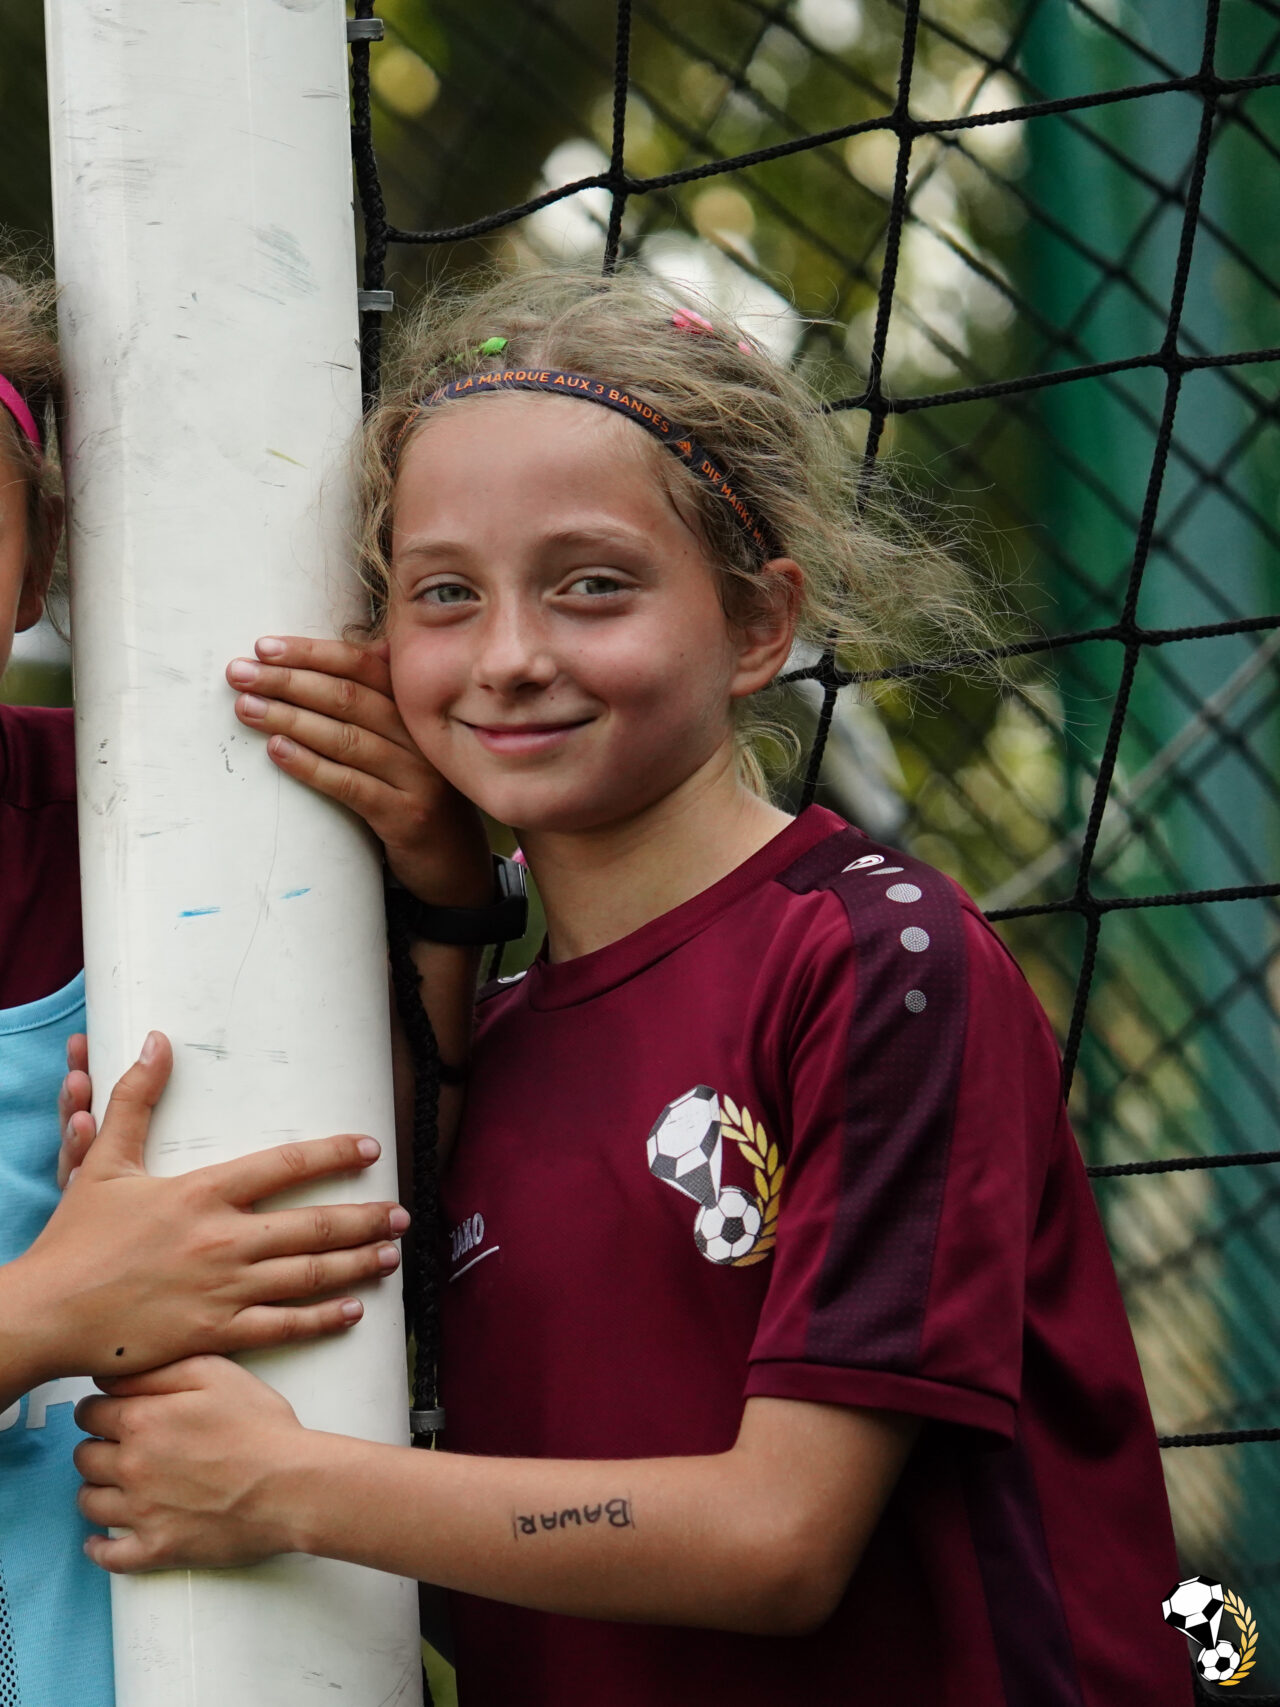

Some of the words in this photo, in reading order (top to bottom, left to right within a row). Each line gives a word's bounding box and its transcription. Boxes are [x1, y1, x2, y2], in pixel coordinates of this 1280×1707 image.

[455, 378, 474, 392] LA
[554, 375, 591, 391] AUX
[594, 384, 605, 394] 3
[608, 389, 670, 433] BANDES
[701, 460, 722, 486] DIE
